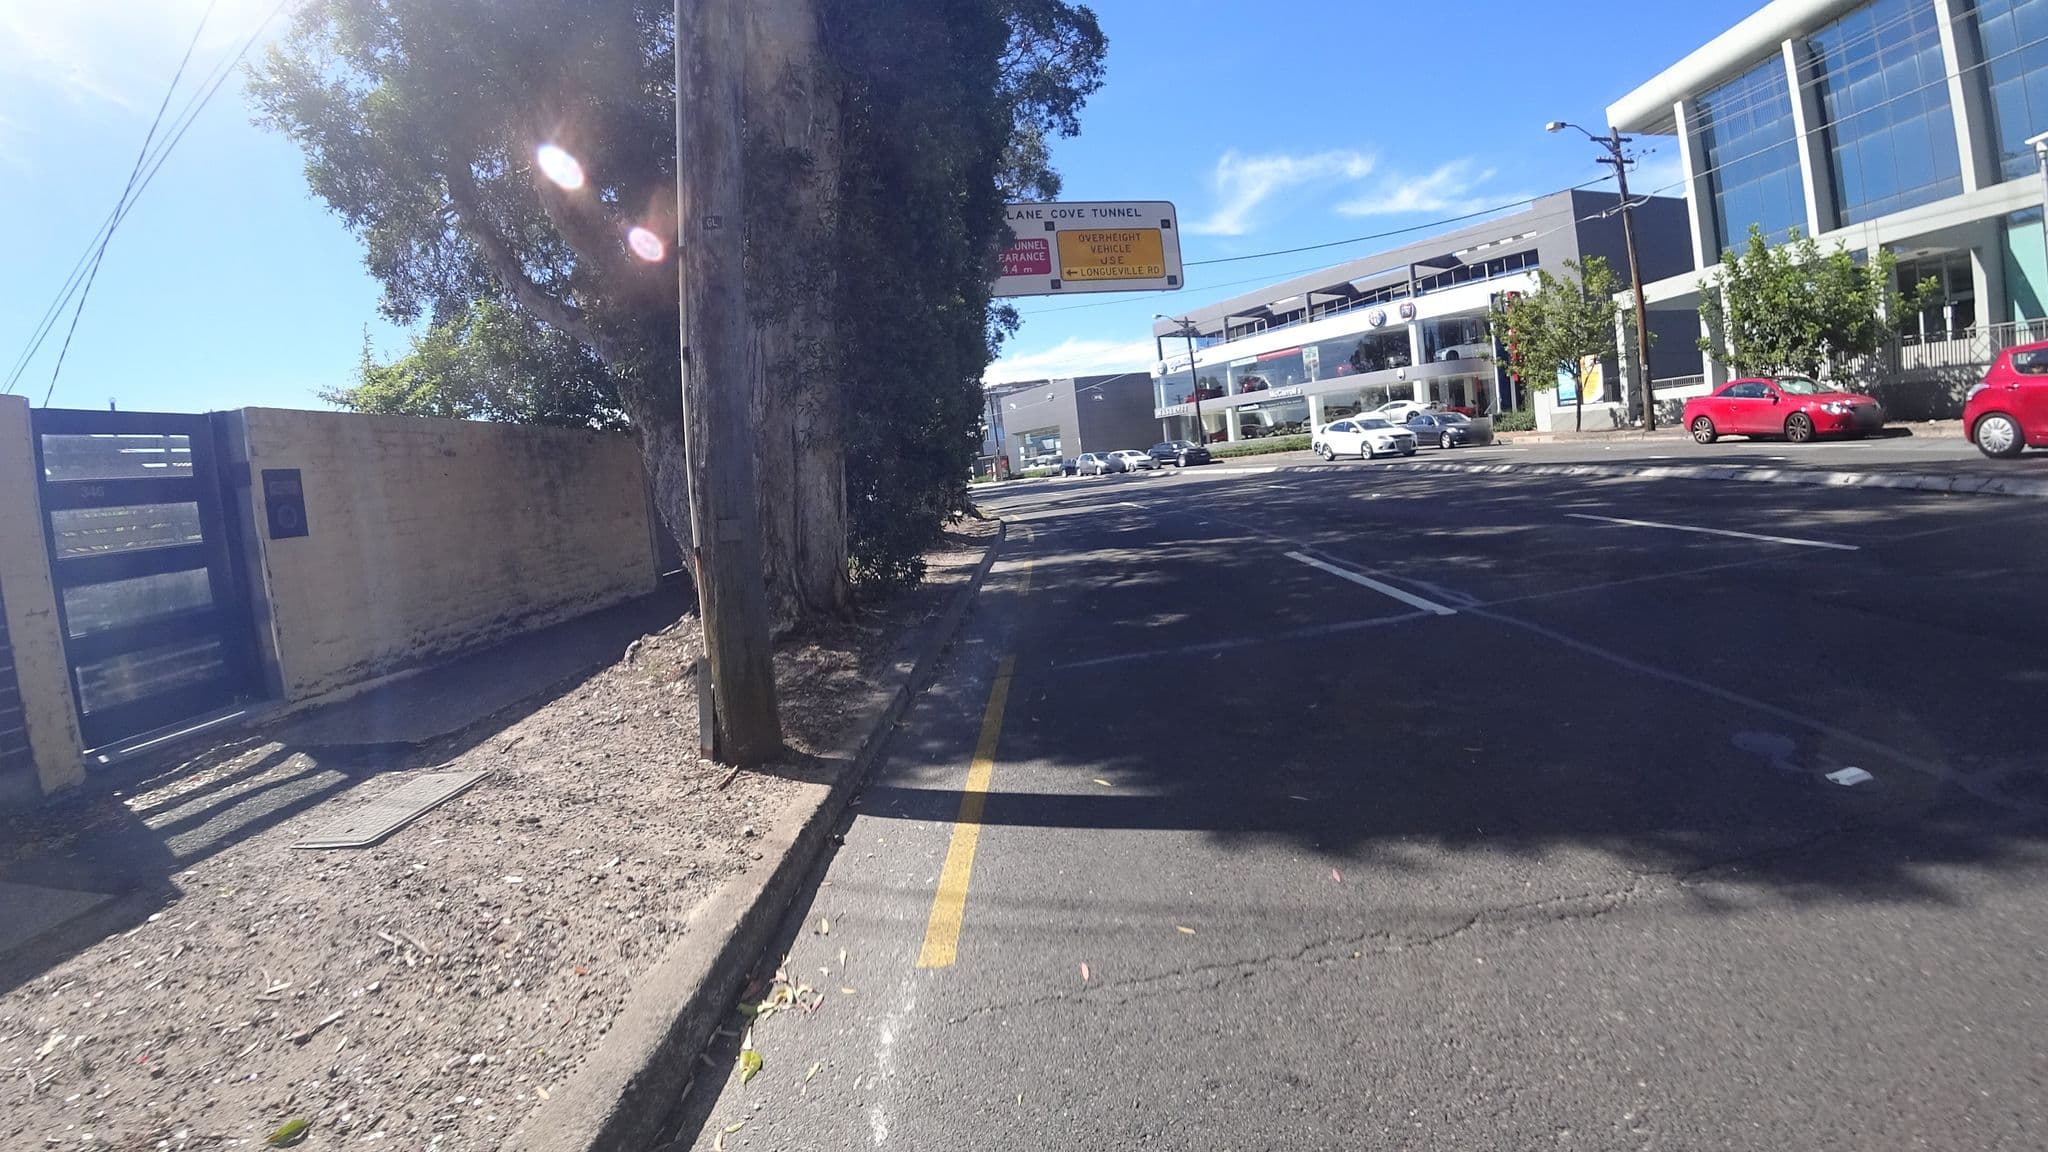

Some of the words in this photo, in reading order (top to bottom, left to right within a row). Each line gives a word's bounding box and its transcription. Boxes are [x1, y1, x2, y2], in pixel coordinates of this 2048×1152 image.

[1007, 210, 1043, 220] LANE
[1051, 209, 1085, 219] COVE
[1092, 208, 1142, 218] TUNNEL
[1078, 233, 1141, 243] OVERHEIGHT
[1011, 240, 1047, 251] UNNEL
[1090, 244, 1132, 254] VEHICLE
[997, 252, 1046, 263] EARANCE
[1100, 256, 1125, 265] USE
[1080, 266, 1144, 277] LONGUEVILLE
[1147, 265, 1160, 275] RD
